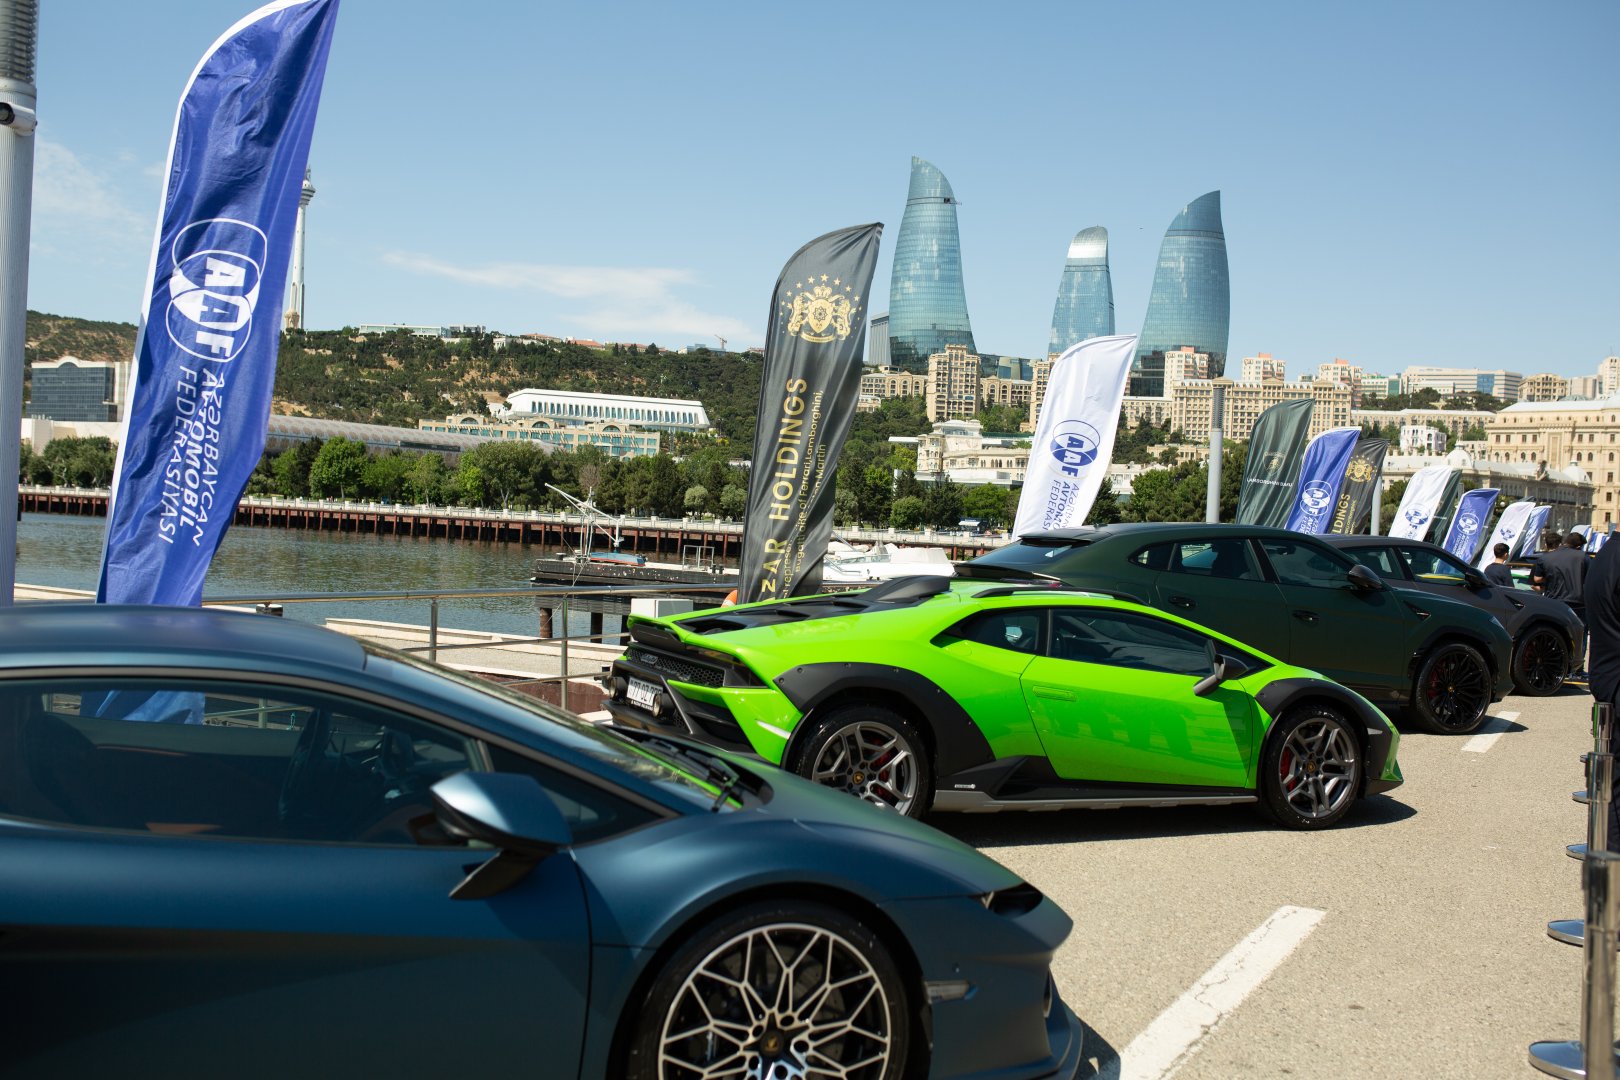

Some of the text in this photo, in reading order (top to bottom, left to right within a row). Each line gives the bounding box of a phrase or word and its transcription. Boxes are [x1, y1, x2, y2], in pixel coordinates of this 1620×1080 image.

[196, 256, 246, 357] AAF
[158, 366, 197, 544] FEDERASİYASI
[769, 378, 807, 522] HOLDINGS
[1062, 436, 1084, 477] AAF
